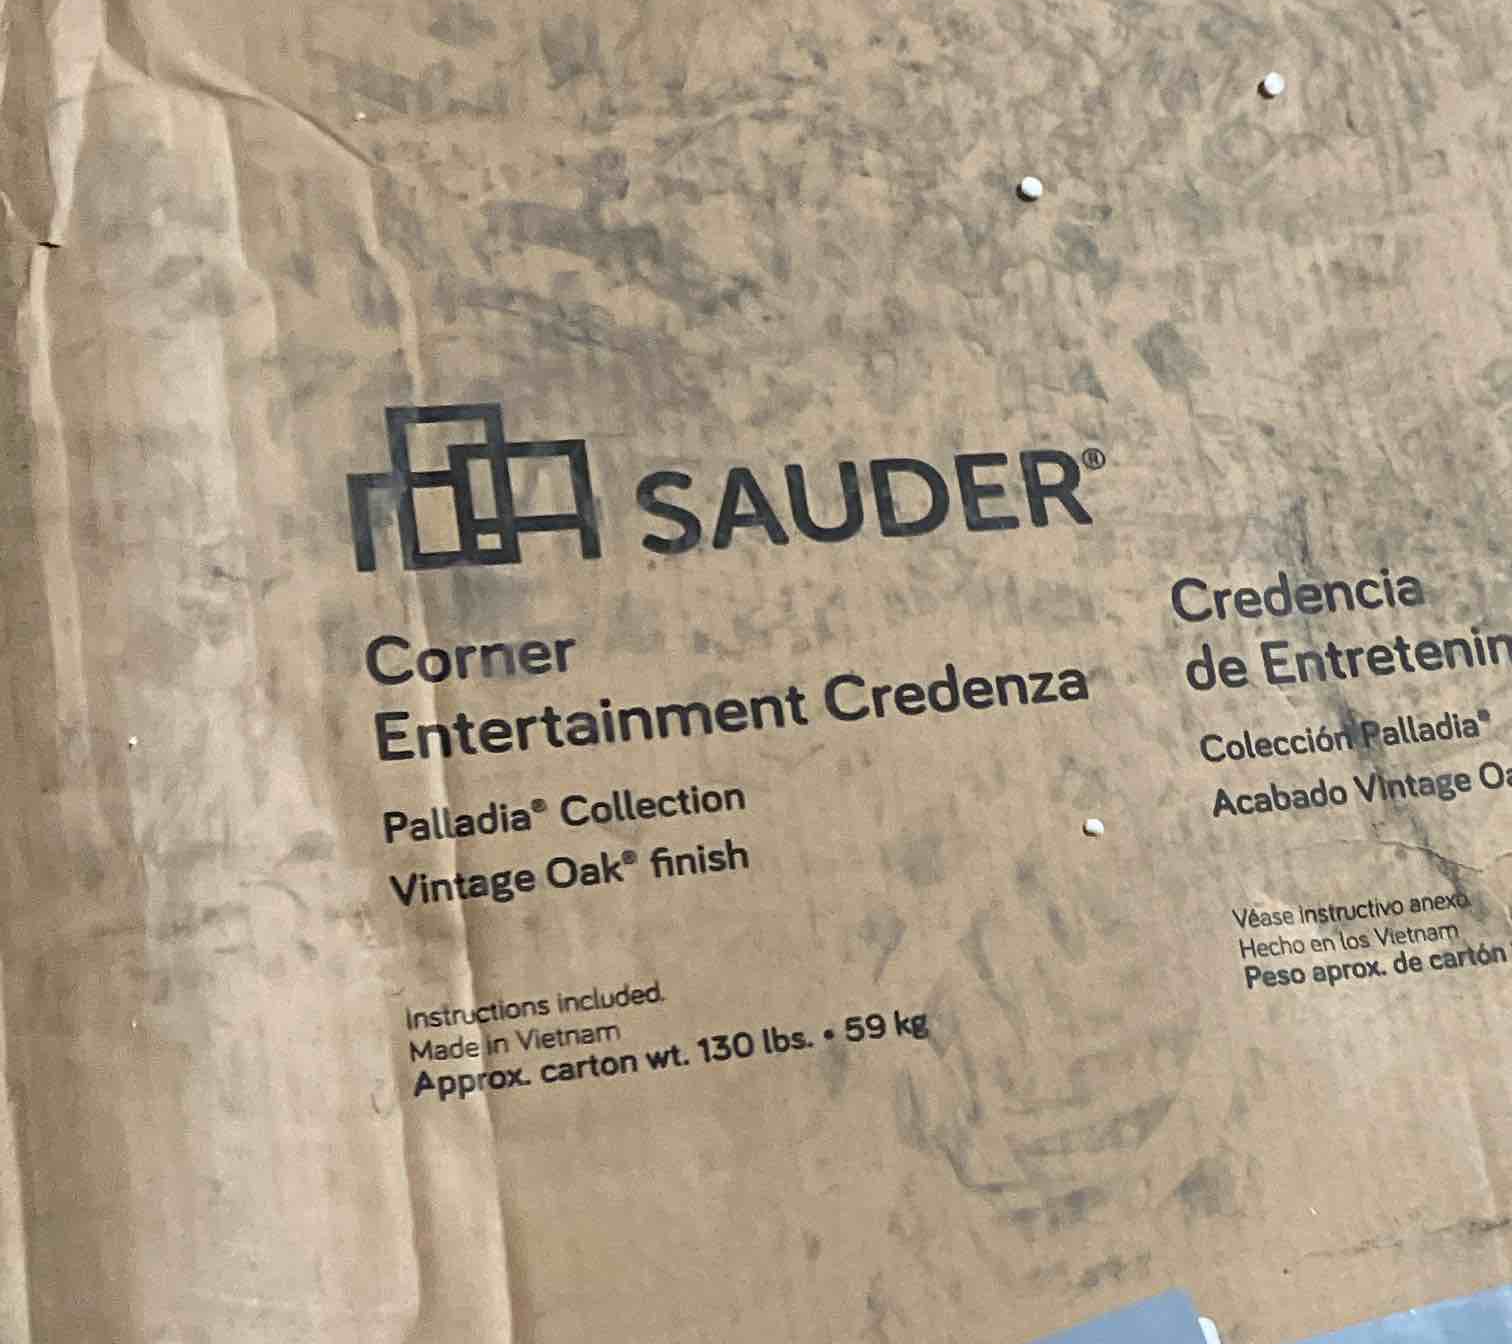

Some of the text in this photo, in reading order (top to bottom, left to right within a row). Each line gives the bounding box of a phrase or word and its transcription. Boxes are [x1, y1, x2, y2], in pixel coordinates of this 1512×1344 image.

[1171, 568, 1425, 625] Credencia
[365, 634, 576, 685] Corner
[1185, 643, 1248, 692] de
[374, 663, 1090, 762] Entertainment Credenza
[1200, 722, 1354, 764] Colección
[560, 783, 747, 829] Collection
[1212, 781, 1348, 819] Acabado
[1354, 767, 1473, 806] Vintage
[389, 858, 536, 907] Vintage
[649, 842, 749, 880] finish
[1233, 905, 1294, 929] Véase
[1298, 897, 1404, 925] instructivo
[1239, 922, 1459, 959] Hecho en los Vietnam
[1245, 963, 1306, 990] Peso
[1312, 958, 1387, 986] aprox.
[1394, 951, 1422, 974] de
[1430, 940, 1507, 971] cartón
[405, 980, 665, 1030] Instructions included.
[409, 1023, 621, 1062] Made in Vietnam
[414, 1010, 929, 1101] Approx. carton wt. 130 lbs. 59 kg
